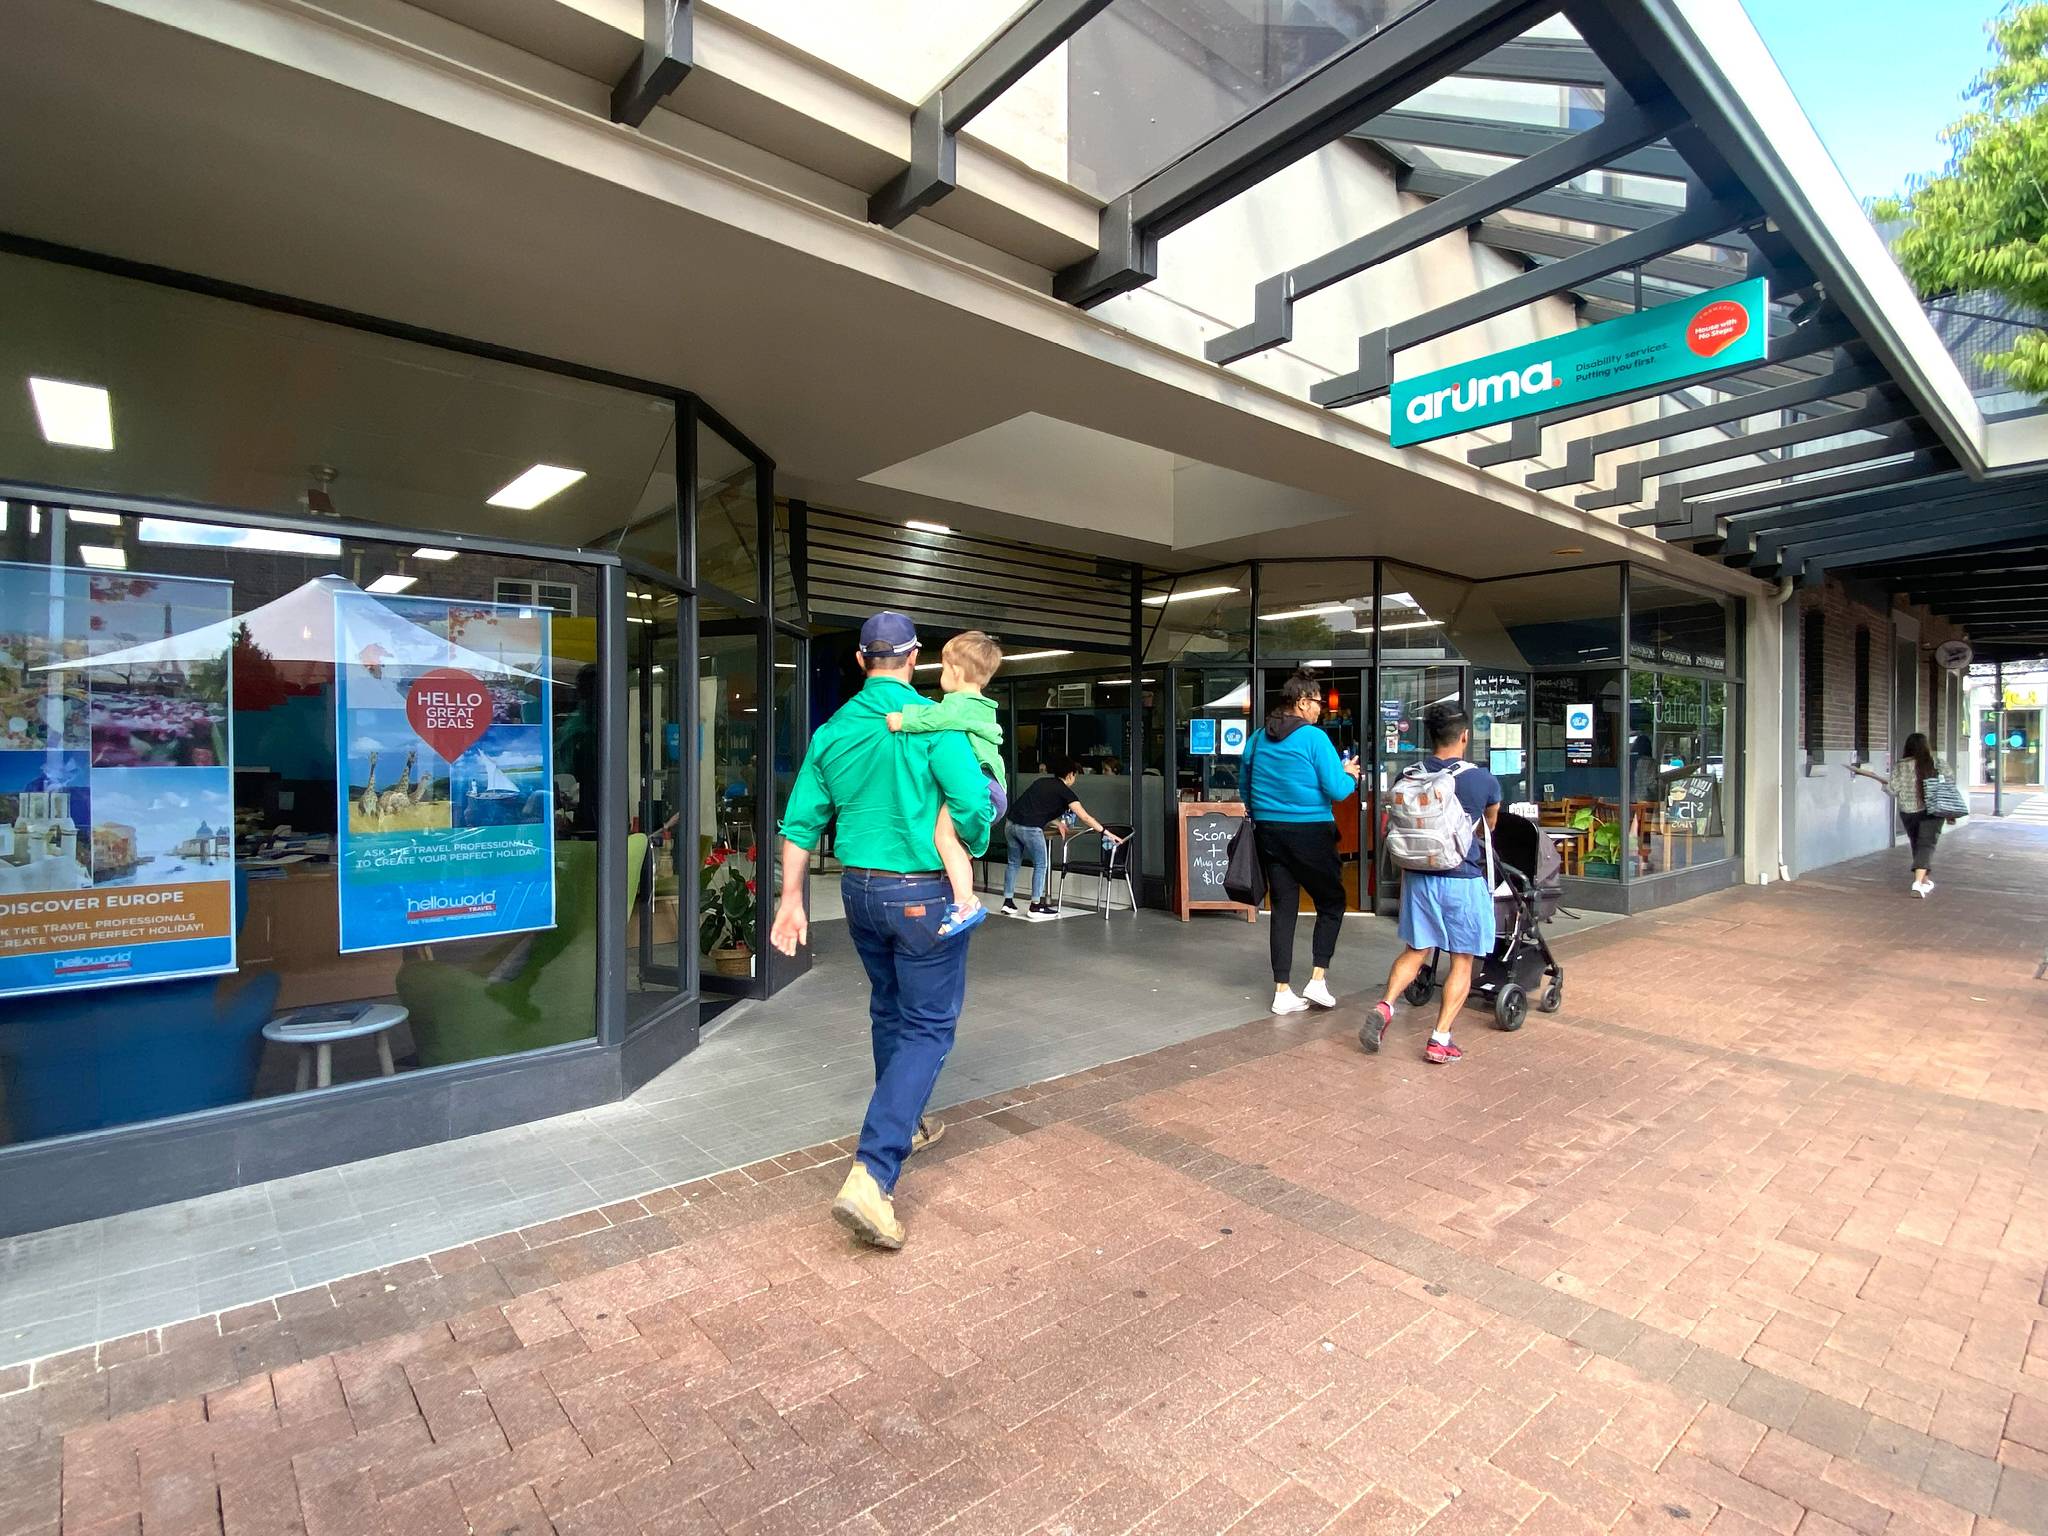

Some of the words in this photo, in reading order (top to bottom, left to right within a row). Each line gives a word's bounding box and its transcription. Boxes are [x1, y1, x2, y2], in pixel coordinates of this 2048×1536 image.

[1695, 323, 1720, 335] House
[1719, 318, 1738, 330] with
[1698, 331, 1711, 341] No
[1711, 327, 1734, 338] Steps
[1576, 352, 1622, 372] Disability
[1576, 366, 1611, 383] Putting
[1613, 362, 1633, 376] you
[418, 691, 482, 707] HELLO
[426, 707, 474, 718] GREAT
[427, 718, 474, 729] DEALS
[355, 859, 371, 869] TO
[374, 857, 415, 867] CREATE
[418, 854, 447, 864] YOUR
[450, 851, 494, 861] PERFECT
[496, 847, 540, 859] HOLIDAY!
[363, 849, 386, 858] ASK
[389, 846, 410, 856] THE
[412, 844, 450, 854] TRAVEL
[454, 839, 534, 851] PROFESSIONALS
[1193, 856, 1213, 871] Mug
[0, 897, 99, 916] DISCOVER
[106, 891, 185, 908] EUROPE
[407, 890, 496, 912] helloworld
[14, 926, 39, 935] THE
[43, 921, 91, 933] TRAVEL
[95, 912, 196, 928] PROFESSIONALS
[50, 933, 86, 944] YOUR
[90, 928, 144, 940] PERFECT
[149, 923, 204, 935] HOLIDAY!
